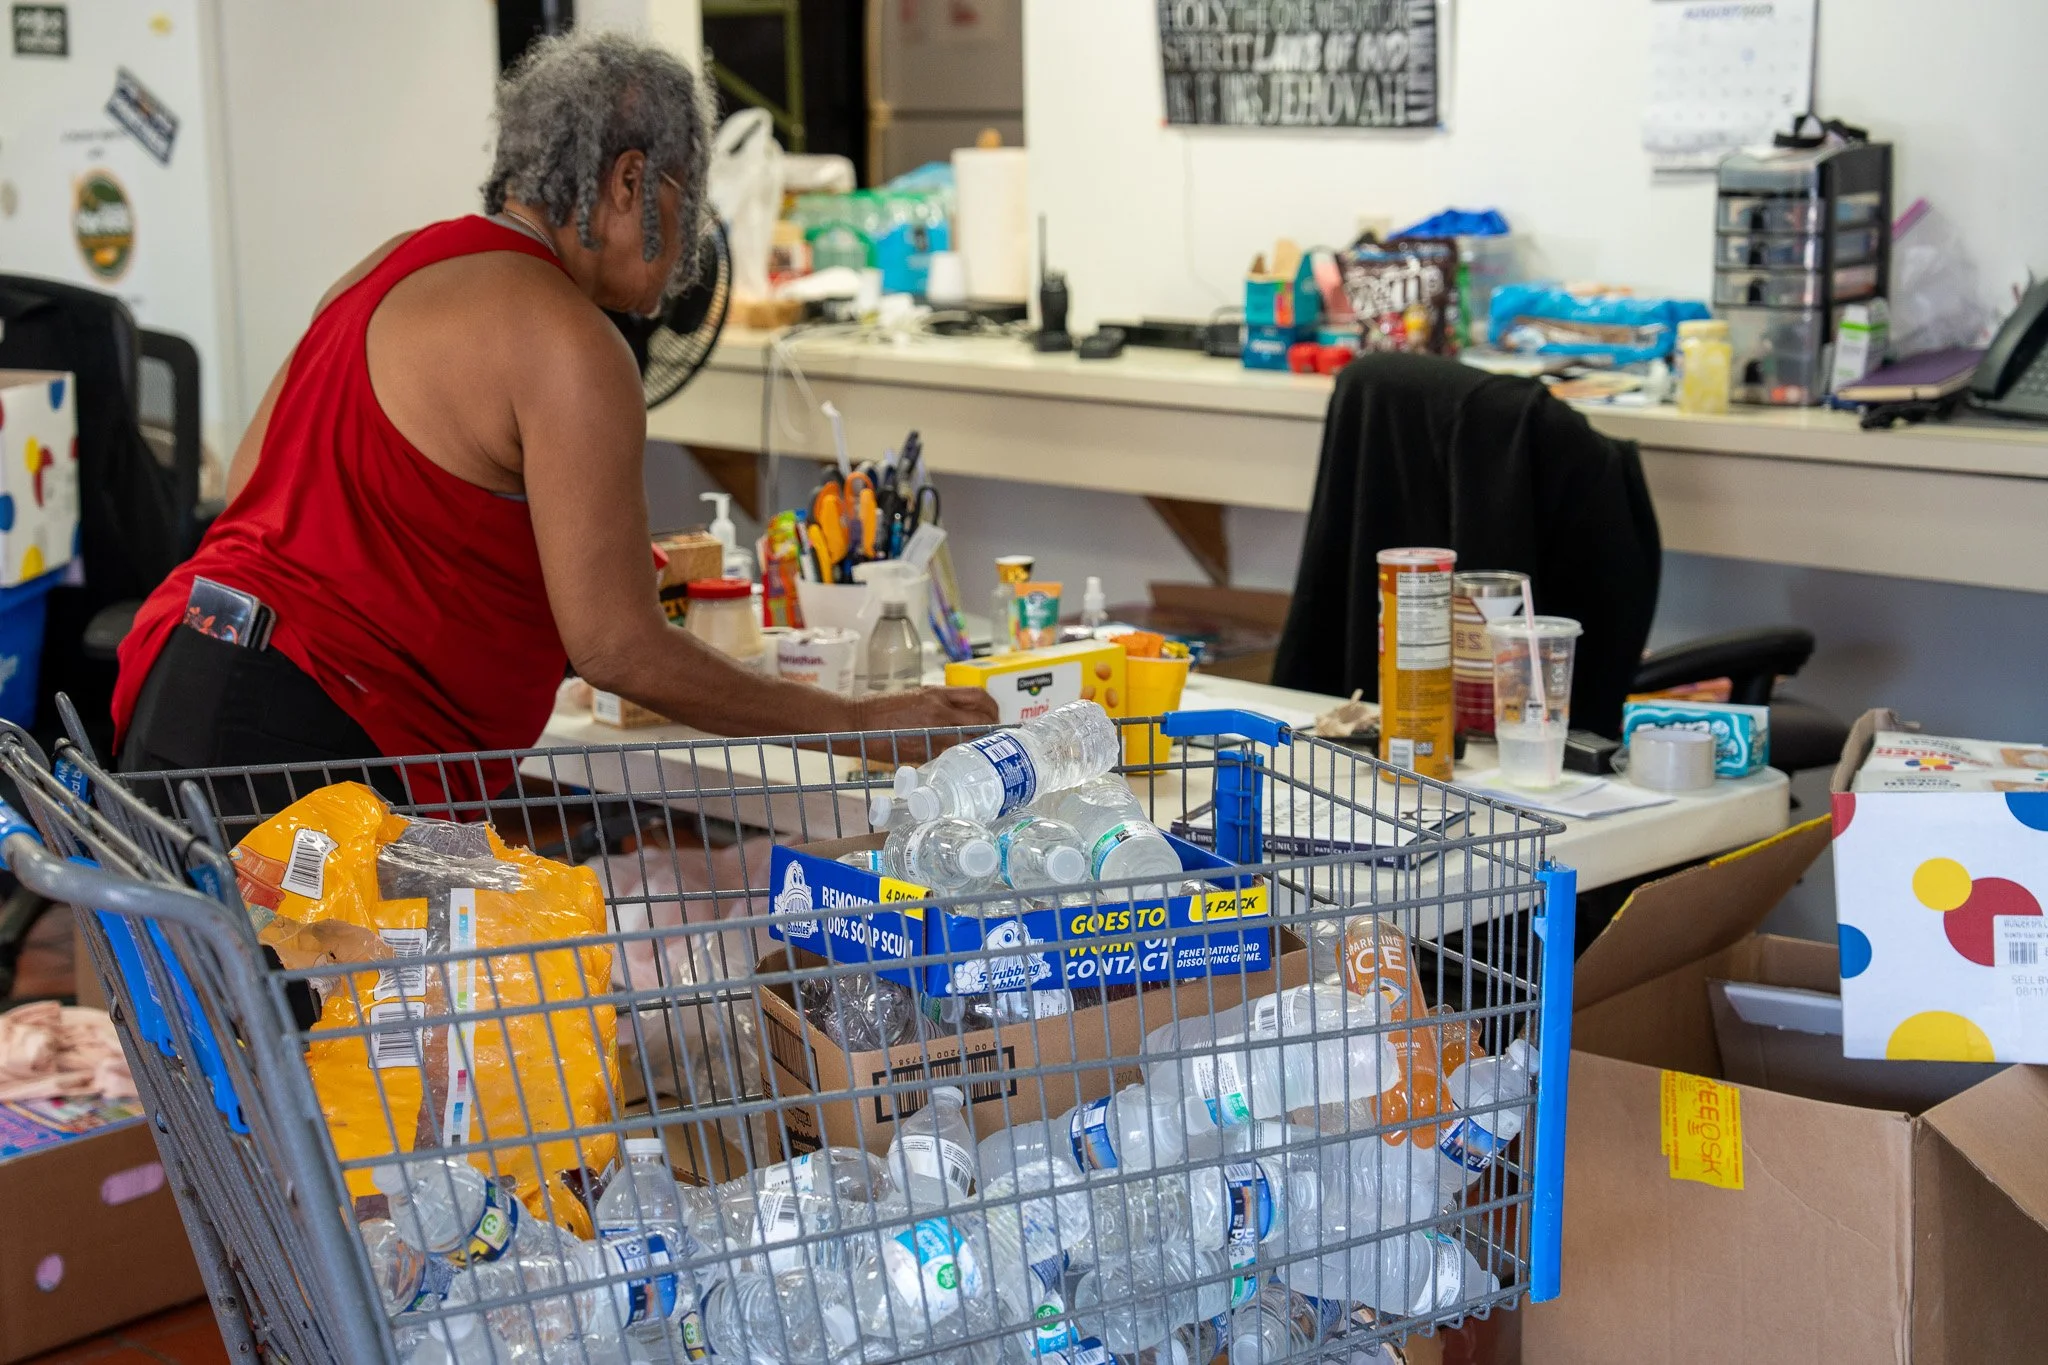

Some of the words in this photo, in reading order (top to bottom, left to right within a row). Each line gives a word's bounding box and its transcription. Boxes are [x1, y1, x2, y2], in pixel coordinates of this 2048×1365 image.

[1215, 896, 1260, 913] PACK
[1070, 910, 1131, 935] GOES
[1137, 907, 1167, 928] TO
[1065, 951, 1171, 981] CONTACT
[1346, 945, 1407, 985] ICE
